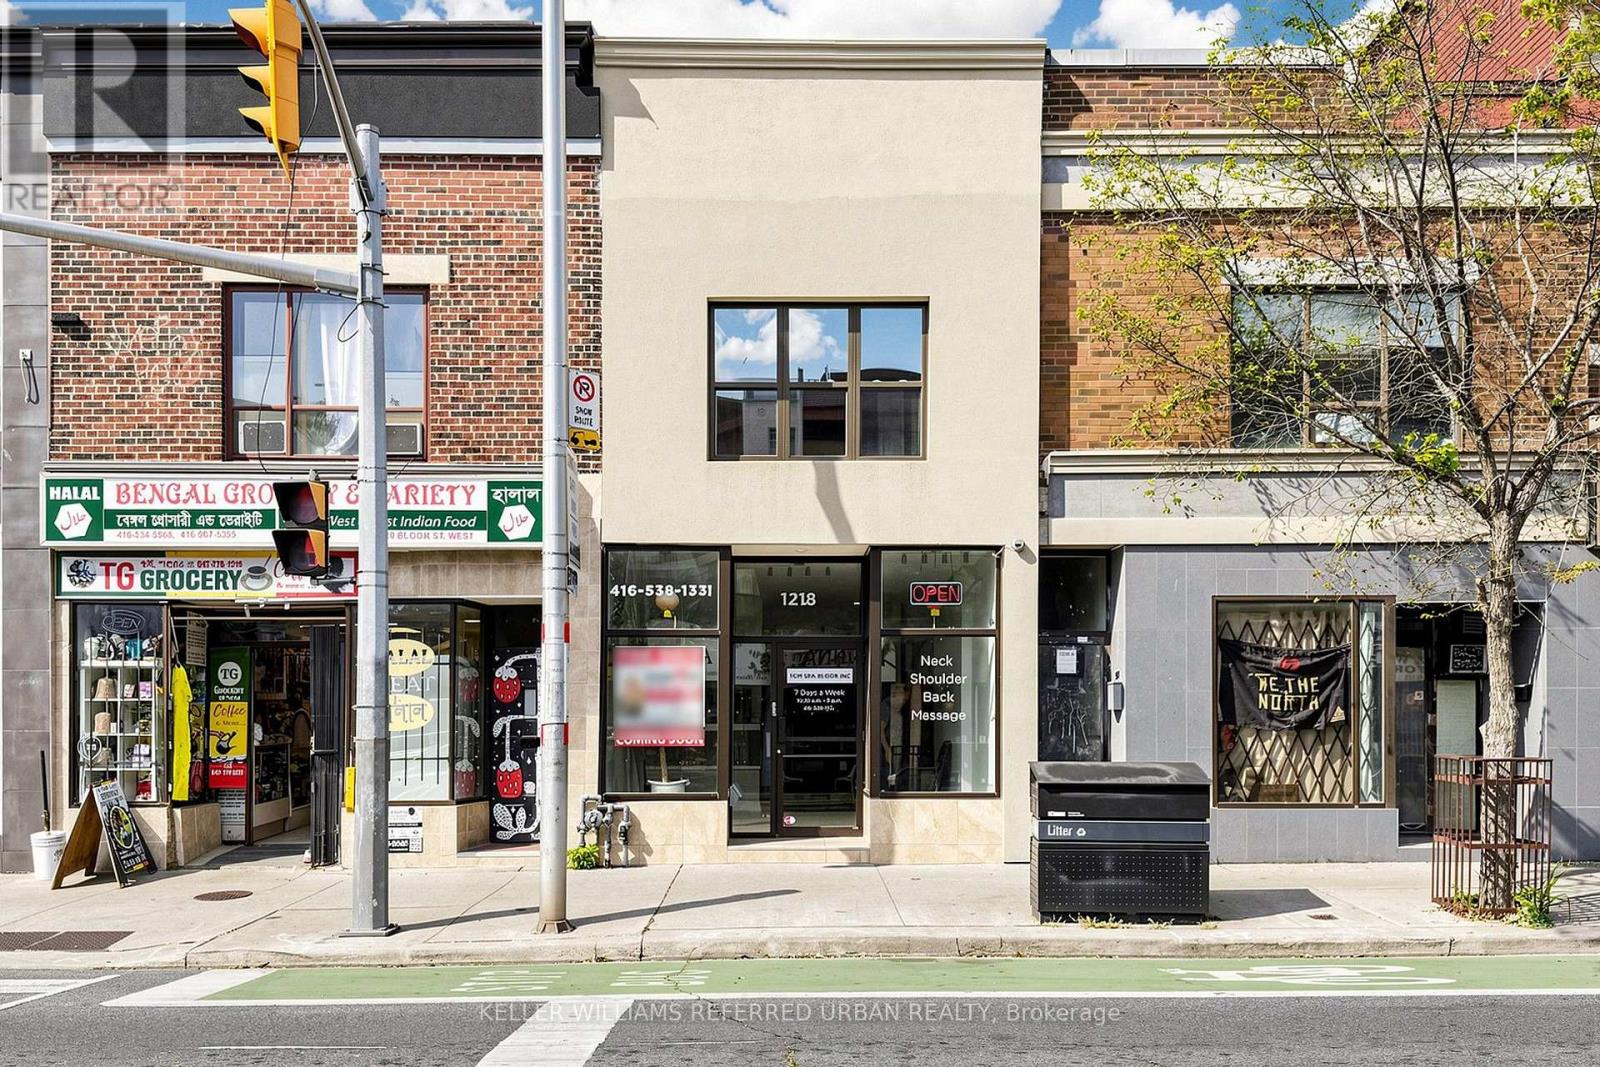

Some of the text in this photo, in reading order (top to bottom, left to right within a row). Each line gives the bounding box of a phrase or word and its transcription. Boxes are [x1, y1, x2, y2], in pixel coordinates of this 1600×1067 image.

[49, 486, 100, 500] HALAL
[115, 483, 216, 505] BENGAL
[387, 483, 476, 506] ARIETY
[400, 514, 440, 528] Indian
[444, 515, 477, 528] Food
[448, 532, 474, 540] WEST
[99, 561, 135, 590] TG
[140, 569, 242, 590] GROCERY
[609, 584, 712, 597] 416-538-1331
[912, 585, 960, 602] OPEN
[780, 592, 816, 606] 1218
[920, 654, 953, 667] Neck
[220, 668, 239, 680] TG
[910, 672, 968, 685] Shoulder
[1284, 676, 1320, 693] THE
[800, 689, 818, 697] Days
[923, 690, 955, 703] Back
[1258, 692, 1320, 711] NORTH
[213, 703, 246, 718] Coffee
[1047, 824, 1073, 836] Litter
